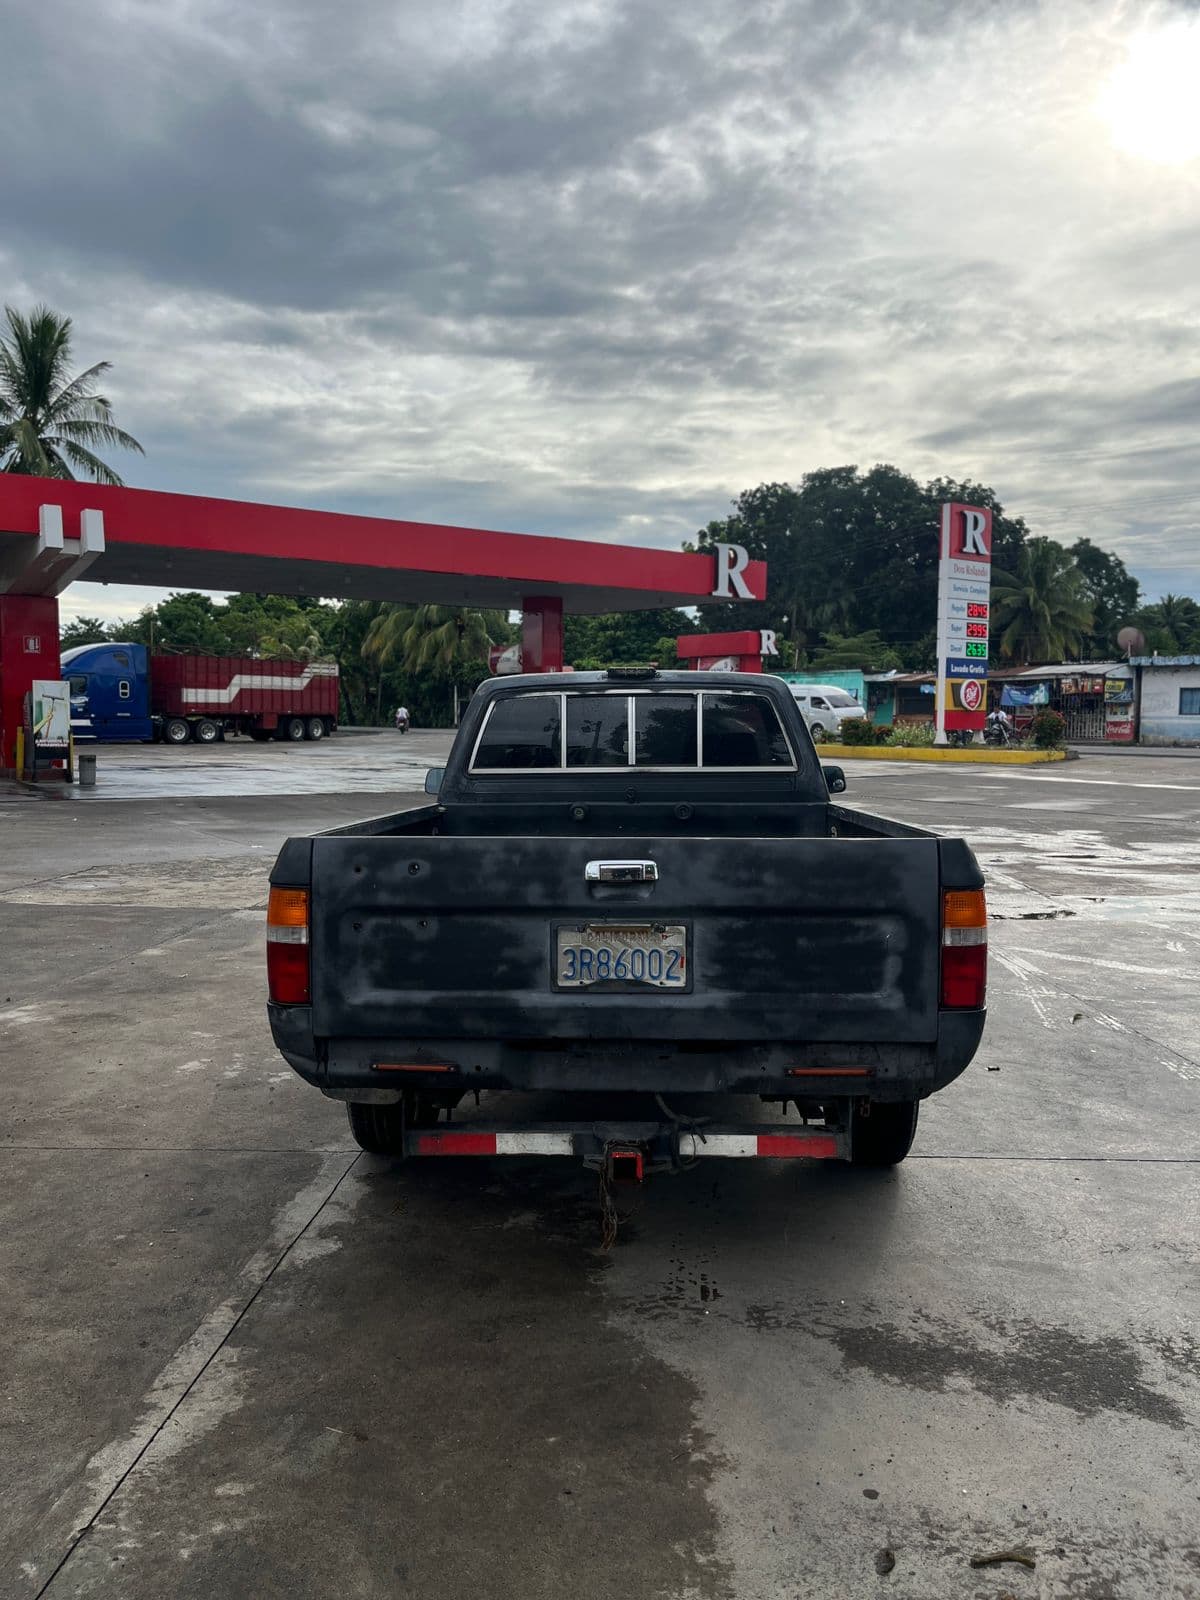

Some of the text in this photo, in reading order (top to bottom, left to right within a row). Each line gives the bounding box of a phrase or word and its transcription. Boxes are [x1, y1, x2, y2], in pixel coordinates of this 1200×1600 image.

[962, 510, 989, 555] R
[711, 543, 756, 599] R
[760, 629, 779, 656] R
[969, 665, 985, 674] Gratis
[562, 948, 682, 982] 3R86002
